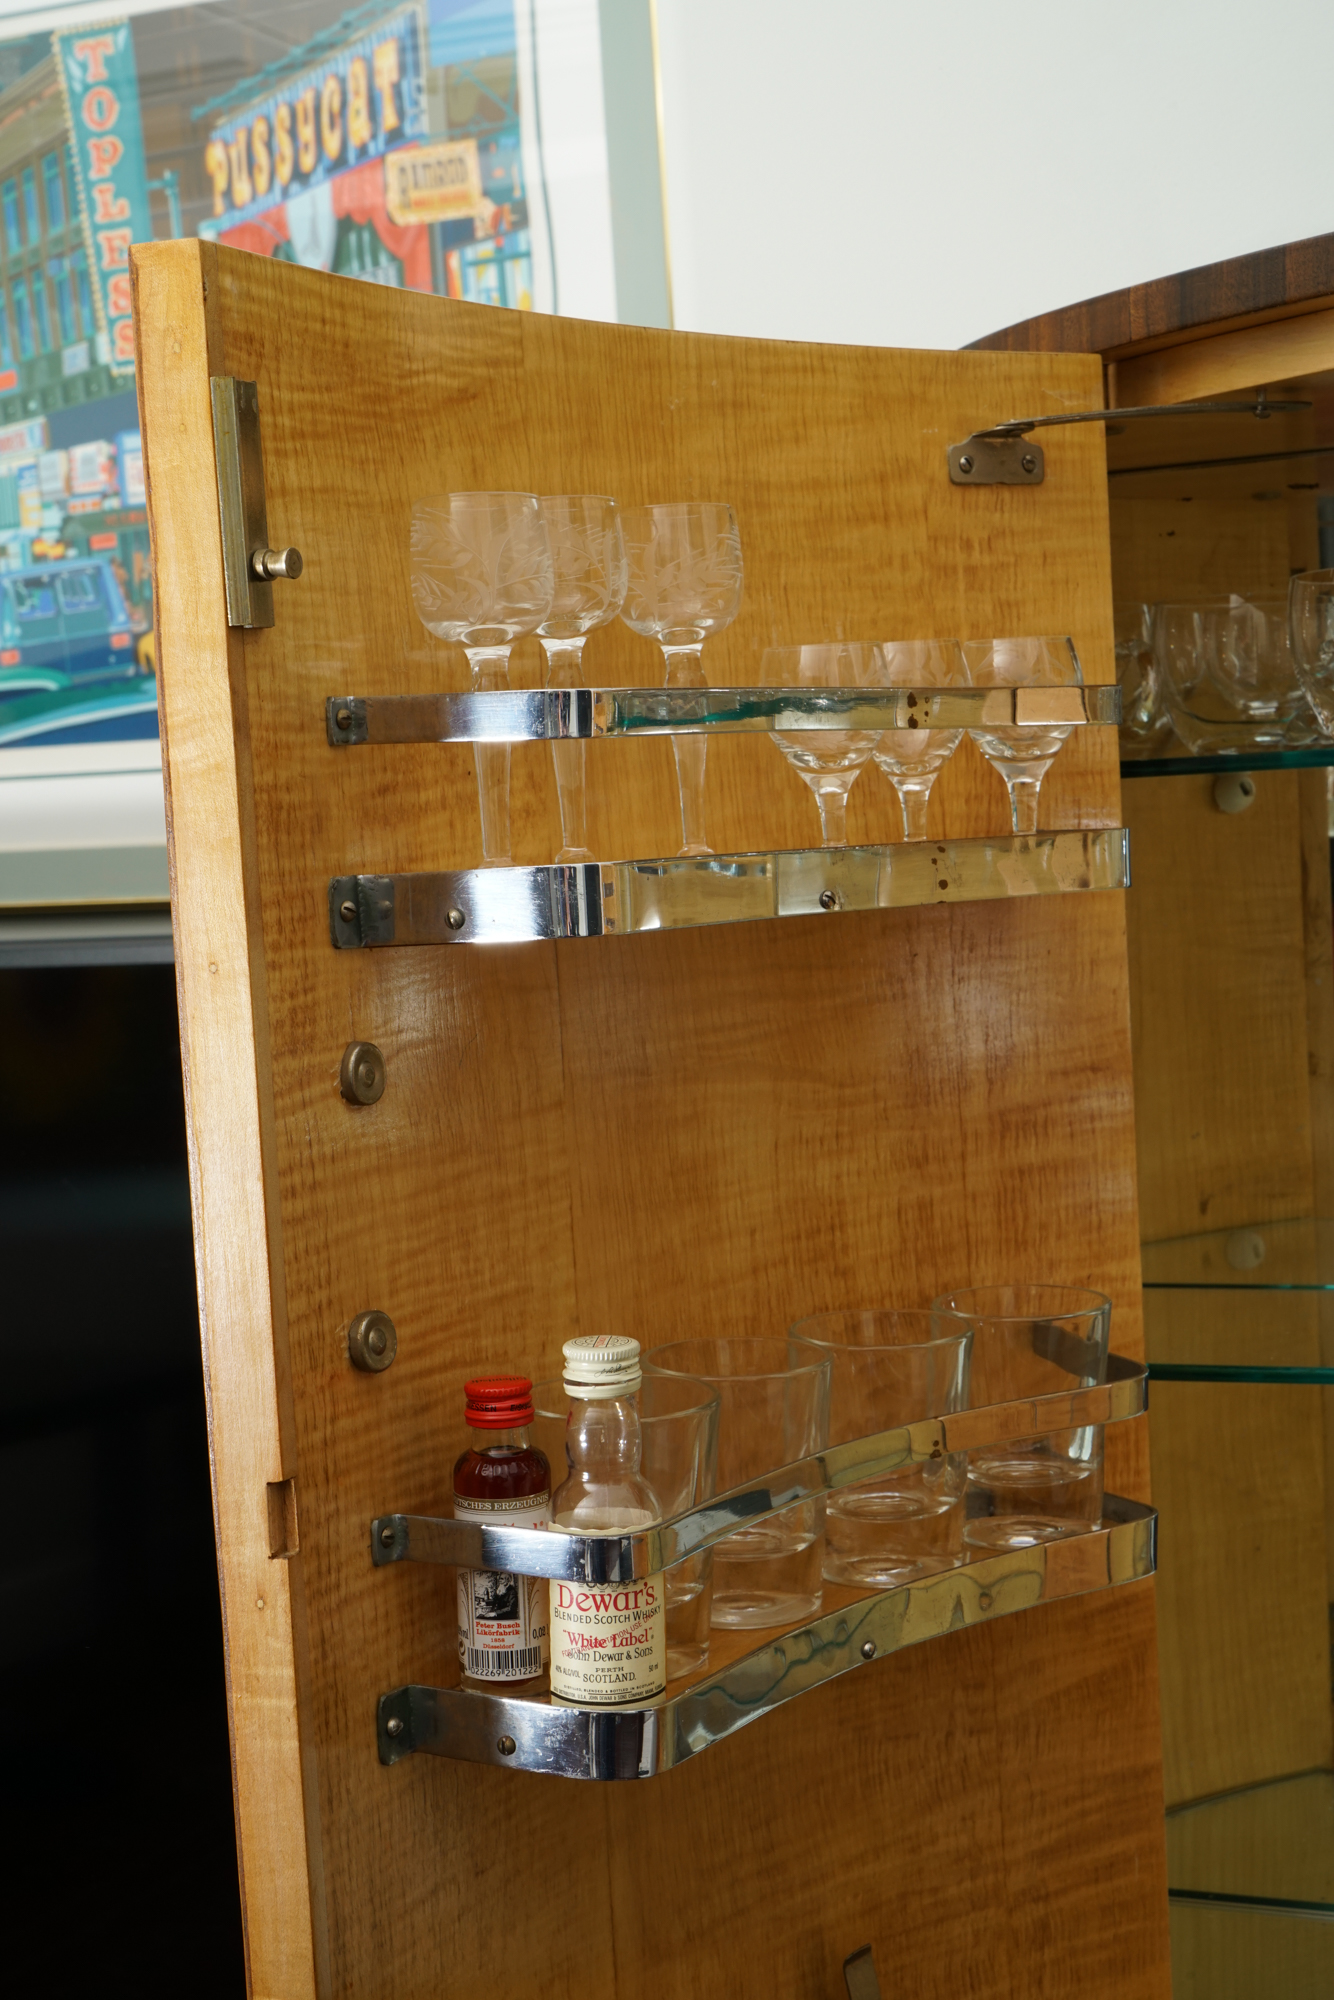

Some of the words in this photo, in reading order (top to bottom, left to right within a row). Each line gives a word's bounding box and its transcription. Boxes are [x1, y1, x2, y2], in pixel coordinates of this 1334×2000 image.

[73, 34, 134, 361] TOPLESS
[454, 1499, 492, 1510] UTSCHES
[494, 1494, 549, 1510] ERZEUGNIS
[557, 1581, 655, 1612] Dewar's
[554, 1607, 592, 1624] BLENDED
[594, 1613, 631, 1625] SCOTCH
[632, 1604, 661, 1622] WHISKY
[475, 1621, 495, 1629] Peter
[476, 1628, 520, 1636] Likörfabrik
[629, 1619, 644, 1632] USE
[532, 1626, 546, 1640] 0,02
[567, 1648, 590, 1662] John
[593, 1650, 624, 1662] Dewar
[625, 1650, 633, 1660] &
[634, 1646, 653, 1659] Sons
[470, 1666, 501, 1677] 022269
[505, 1665, 539, 1677] 201222
[582, 1672, 637, 1684] SCOTLAND.
